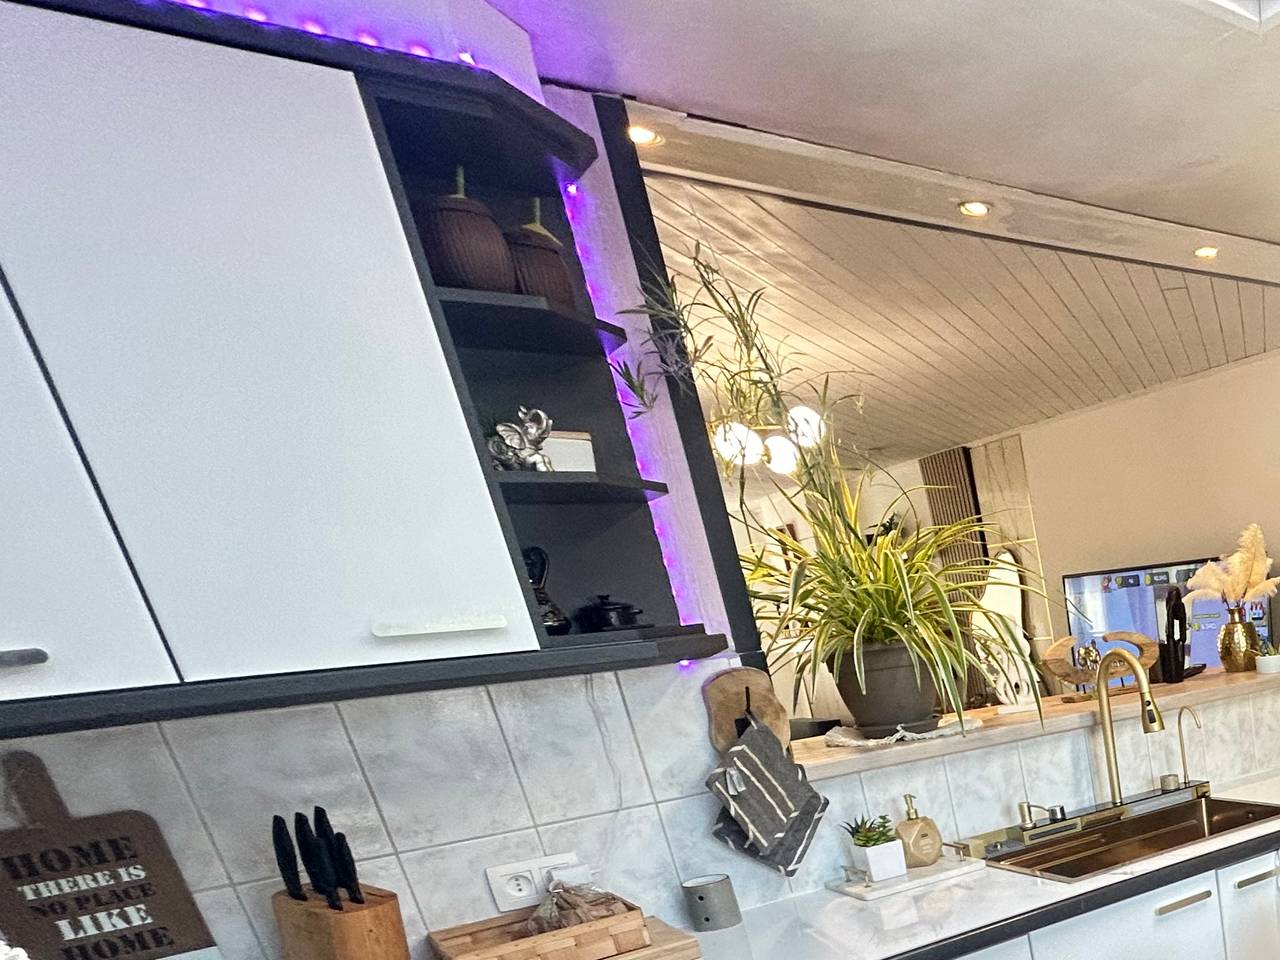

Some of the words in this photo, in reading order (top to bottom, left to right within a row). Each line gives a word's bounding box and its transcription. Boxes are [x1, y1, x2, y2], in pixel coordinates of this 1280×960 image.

[1, 836, 138, 880] HOME
[17, 868, 113, 901] THERE
[119, 864, 147, 882] IS
[29, 901, 69, 918] NO
[74, 882, 158, 911] PLACE
[55, 904, 154, 941] LIKE
